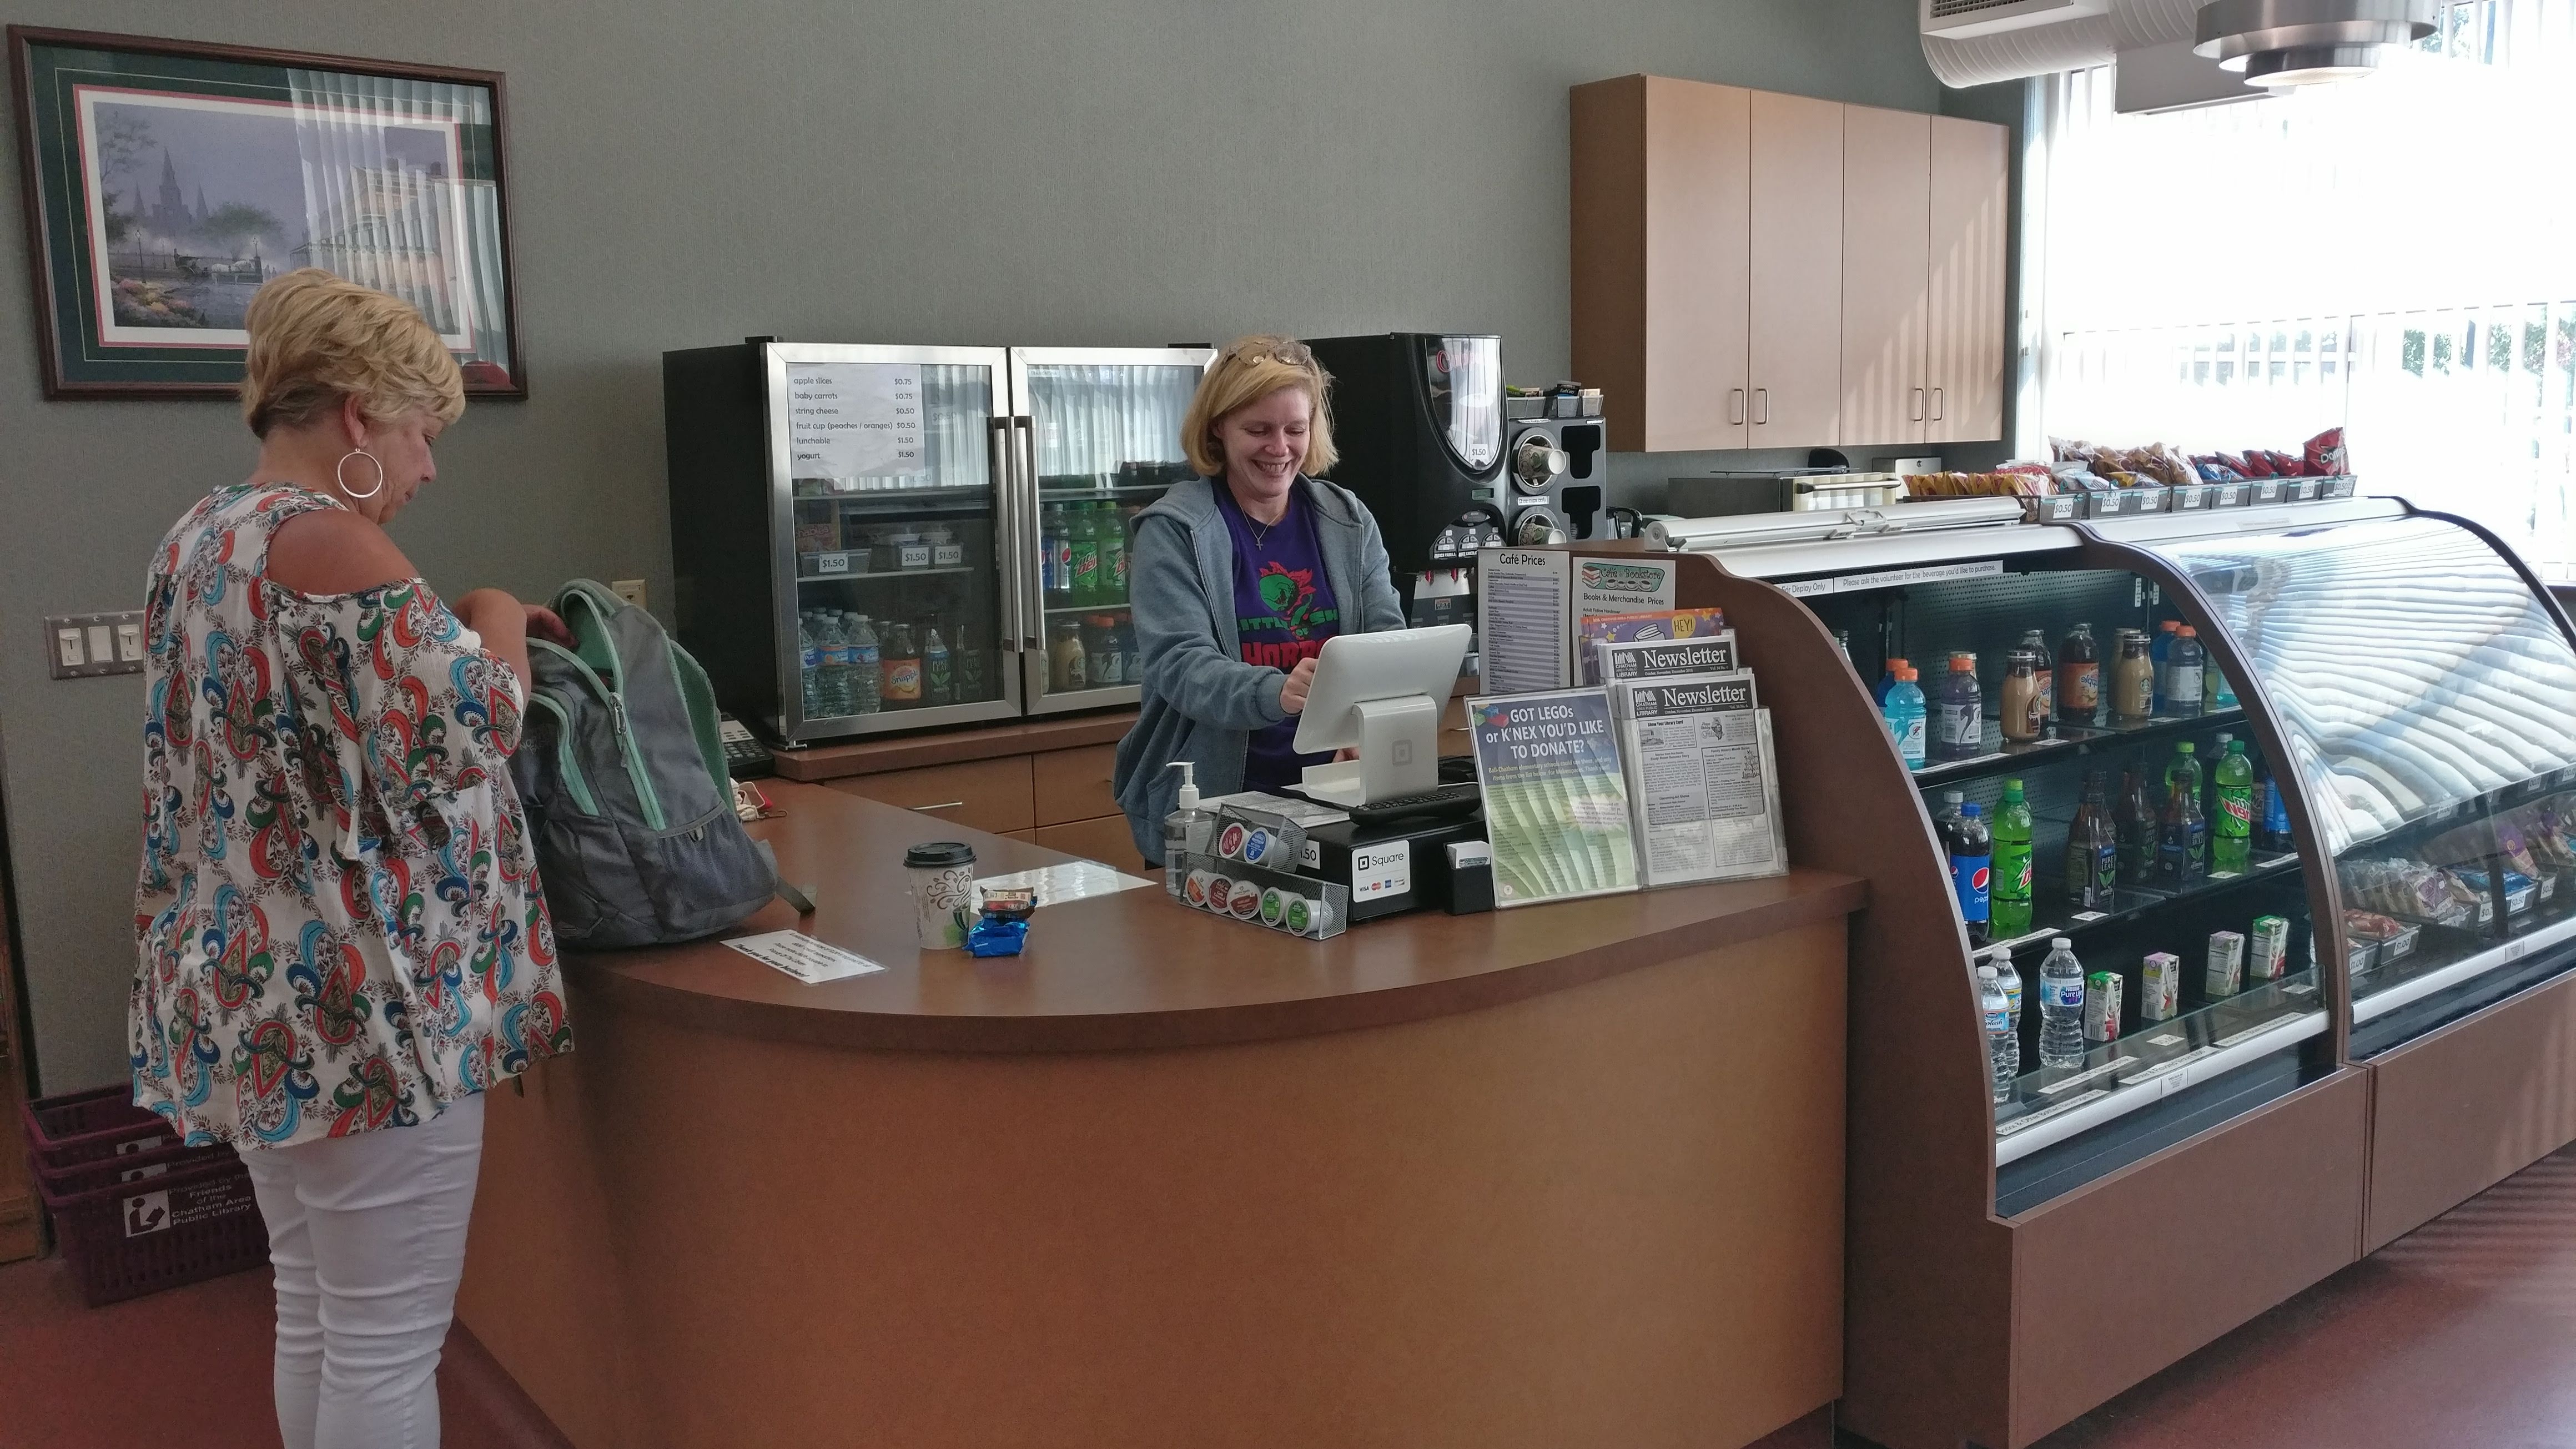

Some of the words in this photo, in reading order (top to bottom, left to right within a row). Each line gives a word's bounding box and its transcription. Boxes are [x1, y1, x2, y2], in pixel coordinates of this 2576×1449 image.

[795, 392, 813, 400] baby
[797, 452, 821, 461] yogurt
[2221, 491, 2237, 500] $0.50
[2261, 486, 2276, 495] $0.50
[2102, 499, 2120, 508] $0.50
[2142, 495, 2158, 505] $0.50
[2185, 494, 2201, 503] $0.50
[2055, 504, 2072, 513] $0.50
[905, 553, 927, 562] $1.50
[938, 551, 959, 560] $1.50
[1500, 554, 1519, 565] Café
[1522, 554, 1546, 566] Prices
[822, 559, 845, 568] $1.50
[1601, 568, 1617, 578] Café
[1624, 568, 1661, 580] Bookstore
[1843, 578, 1860, 587] Please
[1861, 576, 1870, 585] ask
[1880, 573, 1904, 583] volunteer
[1923, 569, 1945, 579] beverage
[1945, 567, 1959, 577] you'd
[1975, 564, 1996, 573] purchase.
[1792, 584, 1812, 594] Display
[1813, 582, 1825, 592] Only
[1584, 593, 1601, 601] Books
[1609, 595, 1644, 604] Merchandise
[1648, 597, 1664, 605] Prices
[1674, 618, 1693, 633] HEY!
[1642, 647, 1726, 668] Newsletter
[1662, 685, 1746, 707] Newsletter
[1510, 707, 1534, 723] GOT
[1538, 705, 1574, 721] LEGOs
[1486, 732, 1498, 743] or
[1501, 725, 1537, 742] K'NEX
[1538, 722, 1577, 738] YOU'D
[1579, 720, 1604, 734] LIKE
[1511, 745, 1528, 759] TO
[1531, 739, 1584, 757] DONATE?
[1372, 853, 1404, 867] Square
[2101, 855, 2114, 865] PURE
[2101, 862, 2114, 872] LEAF
[2510, 895, 2525, 908] $0.50
[189, 1185, 232, 1198] Friends
[197, 1196, 207, 1204] of
[172, 1202, 222, 1218] Chatham
[226, 1196, 251, 1206] Area
[173, 1213, 209, 1226] Public
[212, 1204, 251, 1216] Library
